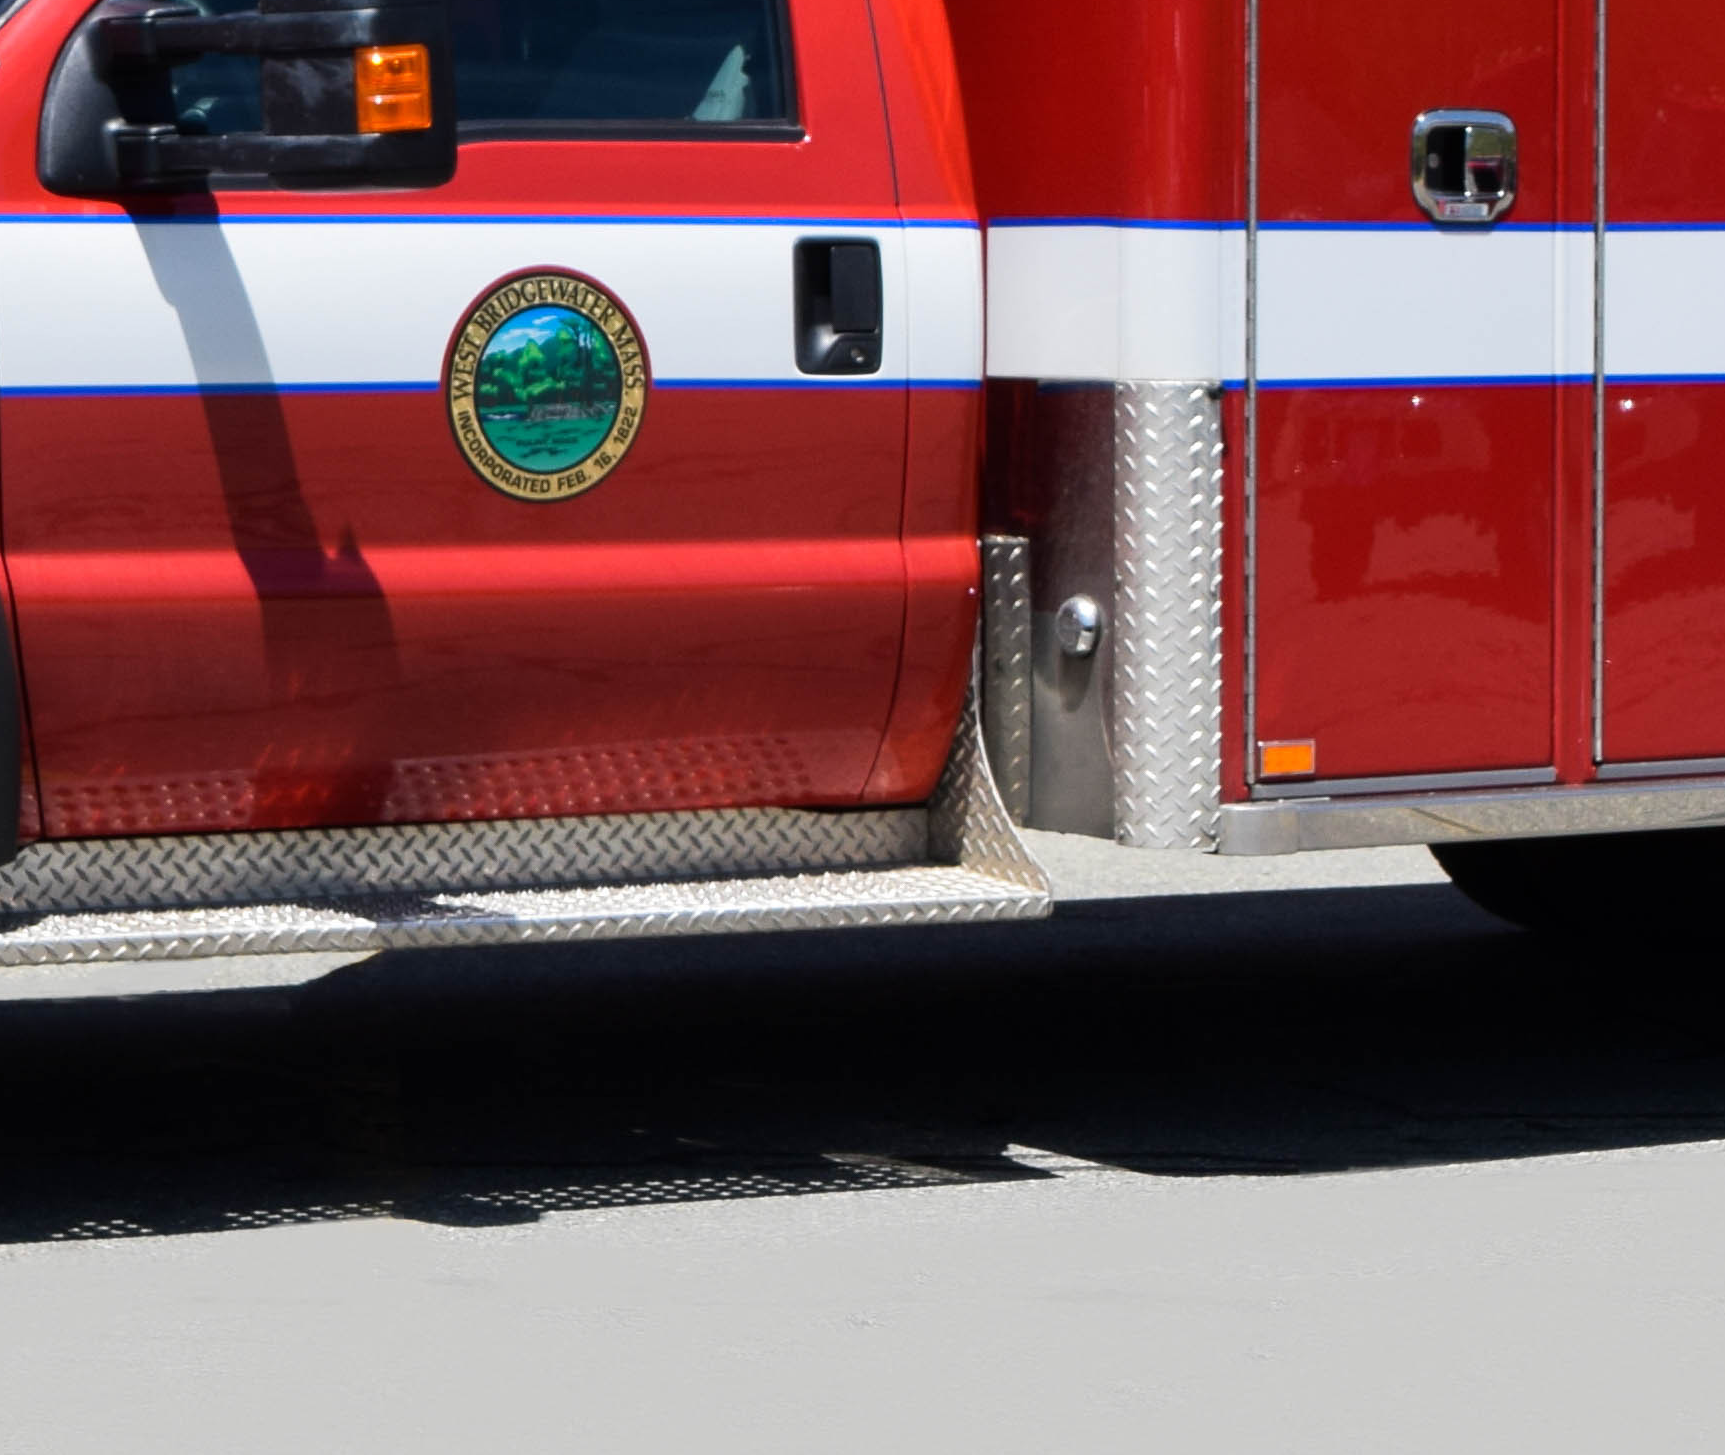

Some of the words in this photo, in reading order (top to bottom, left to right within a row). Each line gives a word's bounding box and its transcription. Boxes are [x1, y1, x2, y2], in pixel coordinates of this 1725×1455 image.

[452, 334, 481, 401] WEST
[476, 277, 617, 333] BRIDGEWATER
[457, 410, 551, 494] INCORPORATED
[614, 406, 638, 446] 1822
